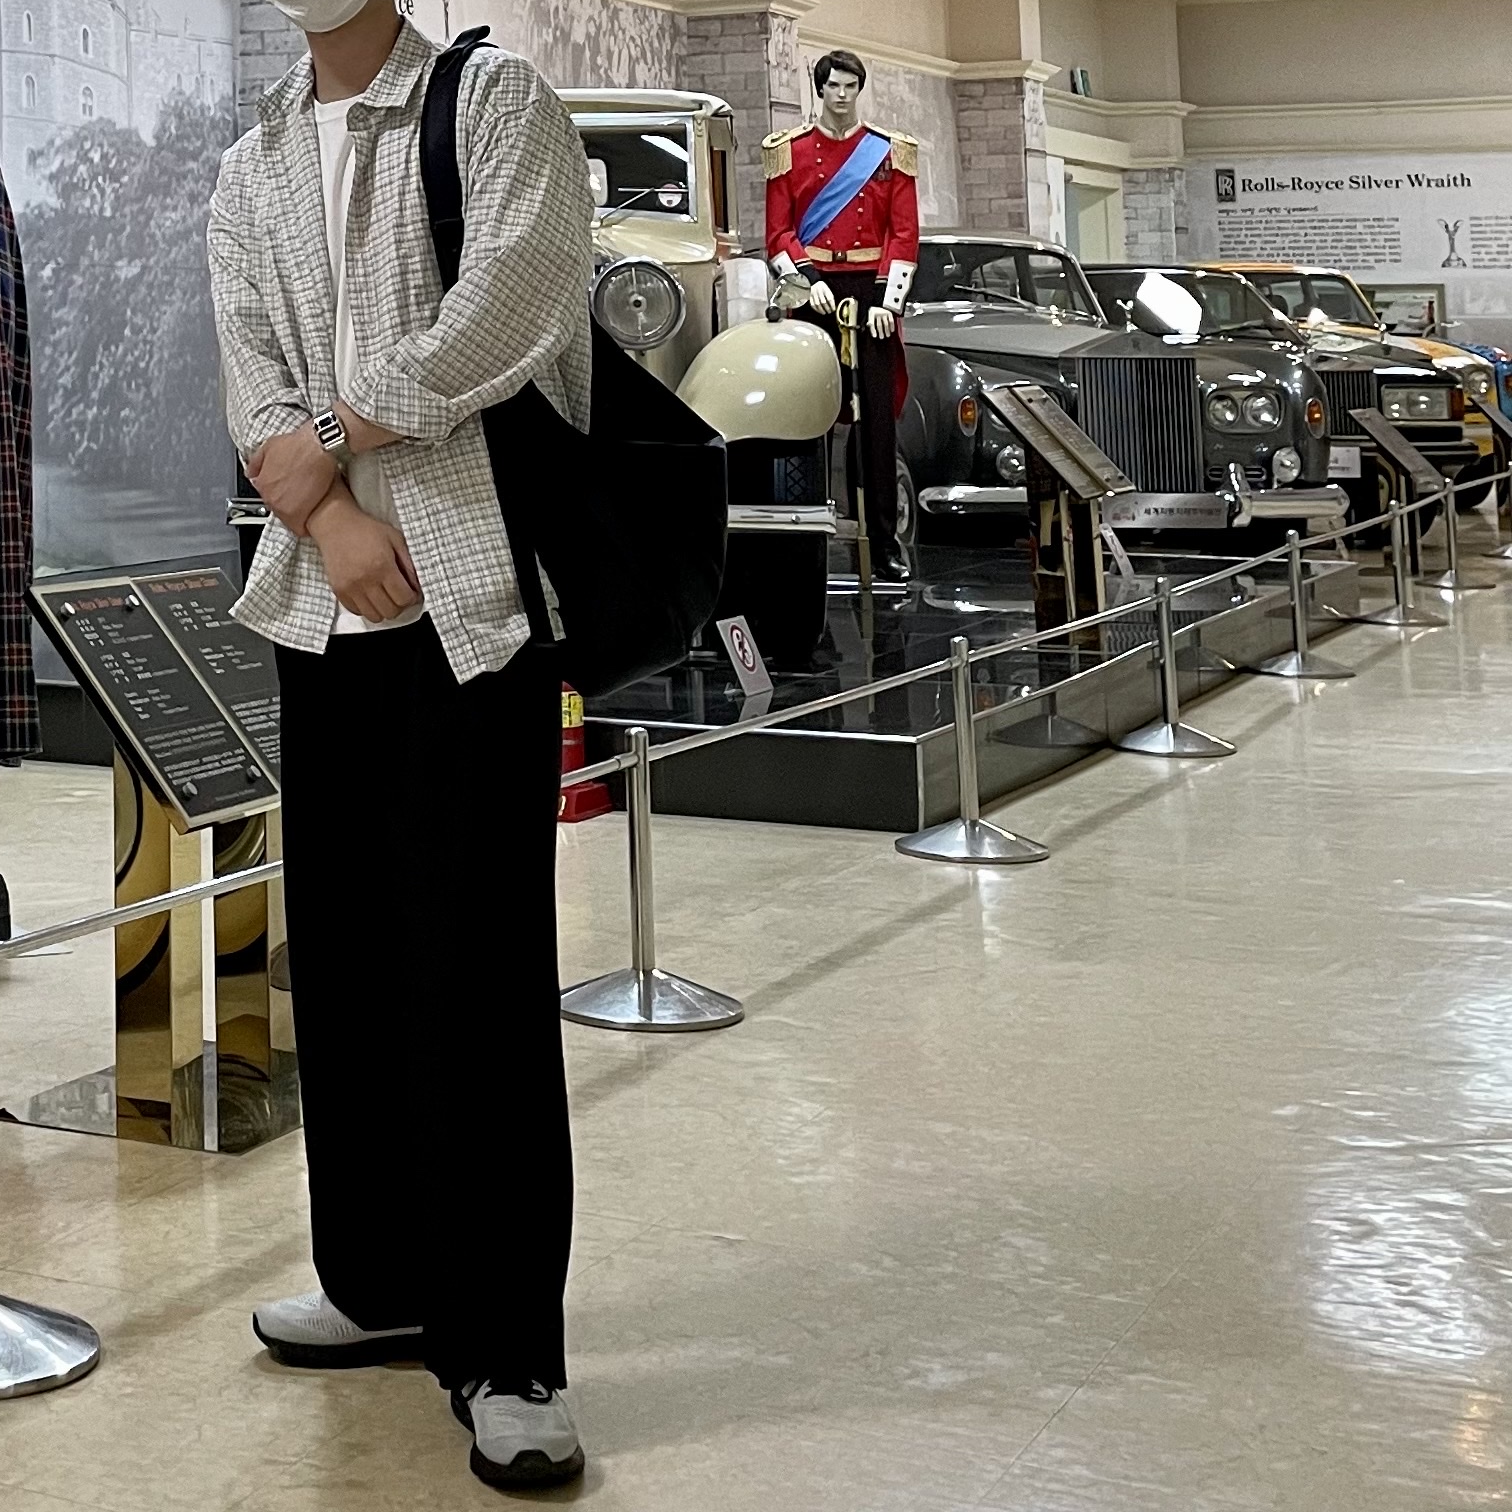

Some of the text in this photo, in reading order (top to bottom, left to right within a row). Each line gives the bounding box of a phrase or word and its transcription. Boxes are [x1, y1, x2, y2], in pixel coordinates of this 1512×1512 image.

[1241, 176, 1344, 193] Rolls-Royce
[1348, 175, 1403, 189] Silver
[1406, 173, 1472, 188] Wraith
